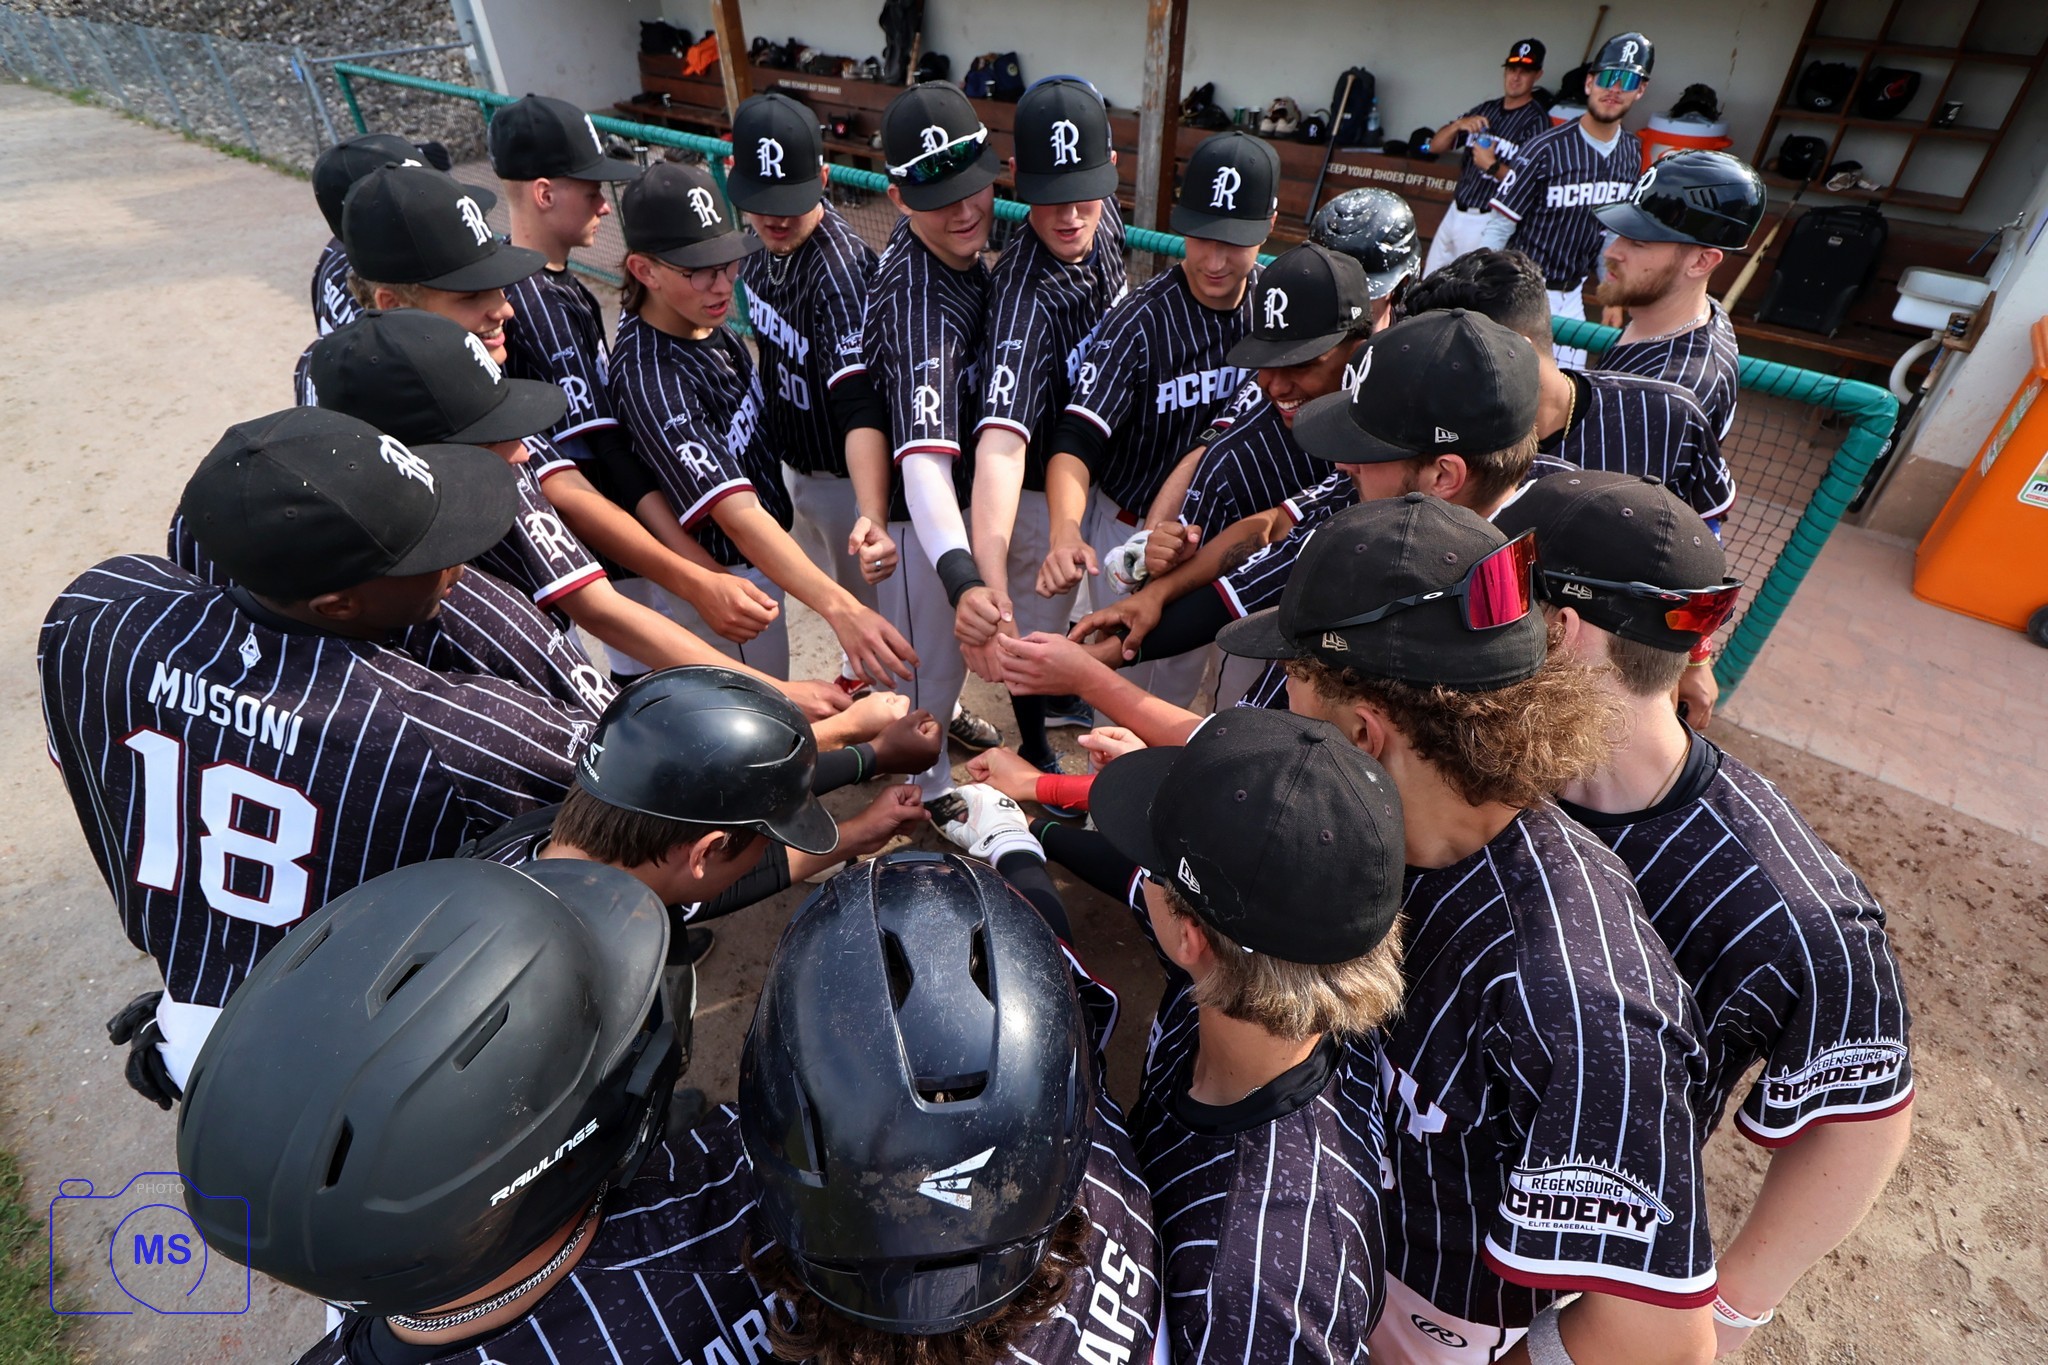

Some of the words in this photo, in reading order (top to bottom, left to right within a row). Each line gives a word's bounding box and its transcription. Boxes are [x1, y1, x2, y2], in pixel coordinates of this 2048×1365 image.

[1327, 163, 1346, 174] EEP
[1348, 165, 1372, 178] YOUR
[1373, 169, 1406, 183] SHOES
[1406, 173, 1426, 186] OFF
[1426, 176, 1445, 190] THE
[147, 661, 303, 756] MUSONI
[117, 725, 323, 928] 18
[1767, 1052, 1901, 1102] ACADEMY
[1811, 1050, 1883, 1074] REGENSBURG
[490, 1117, 598, 1207] RAWLINGS
[1503, 1187, 1657, 1233] CADEMY
[1531, 1177, 1624, 1198] REGENSBURG
[1528, 1220, 1551, 1229] ELITE
[1553, 1221, 1596, 1232] BASEBALL
